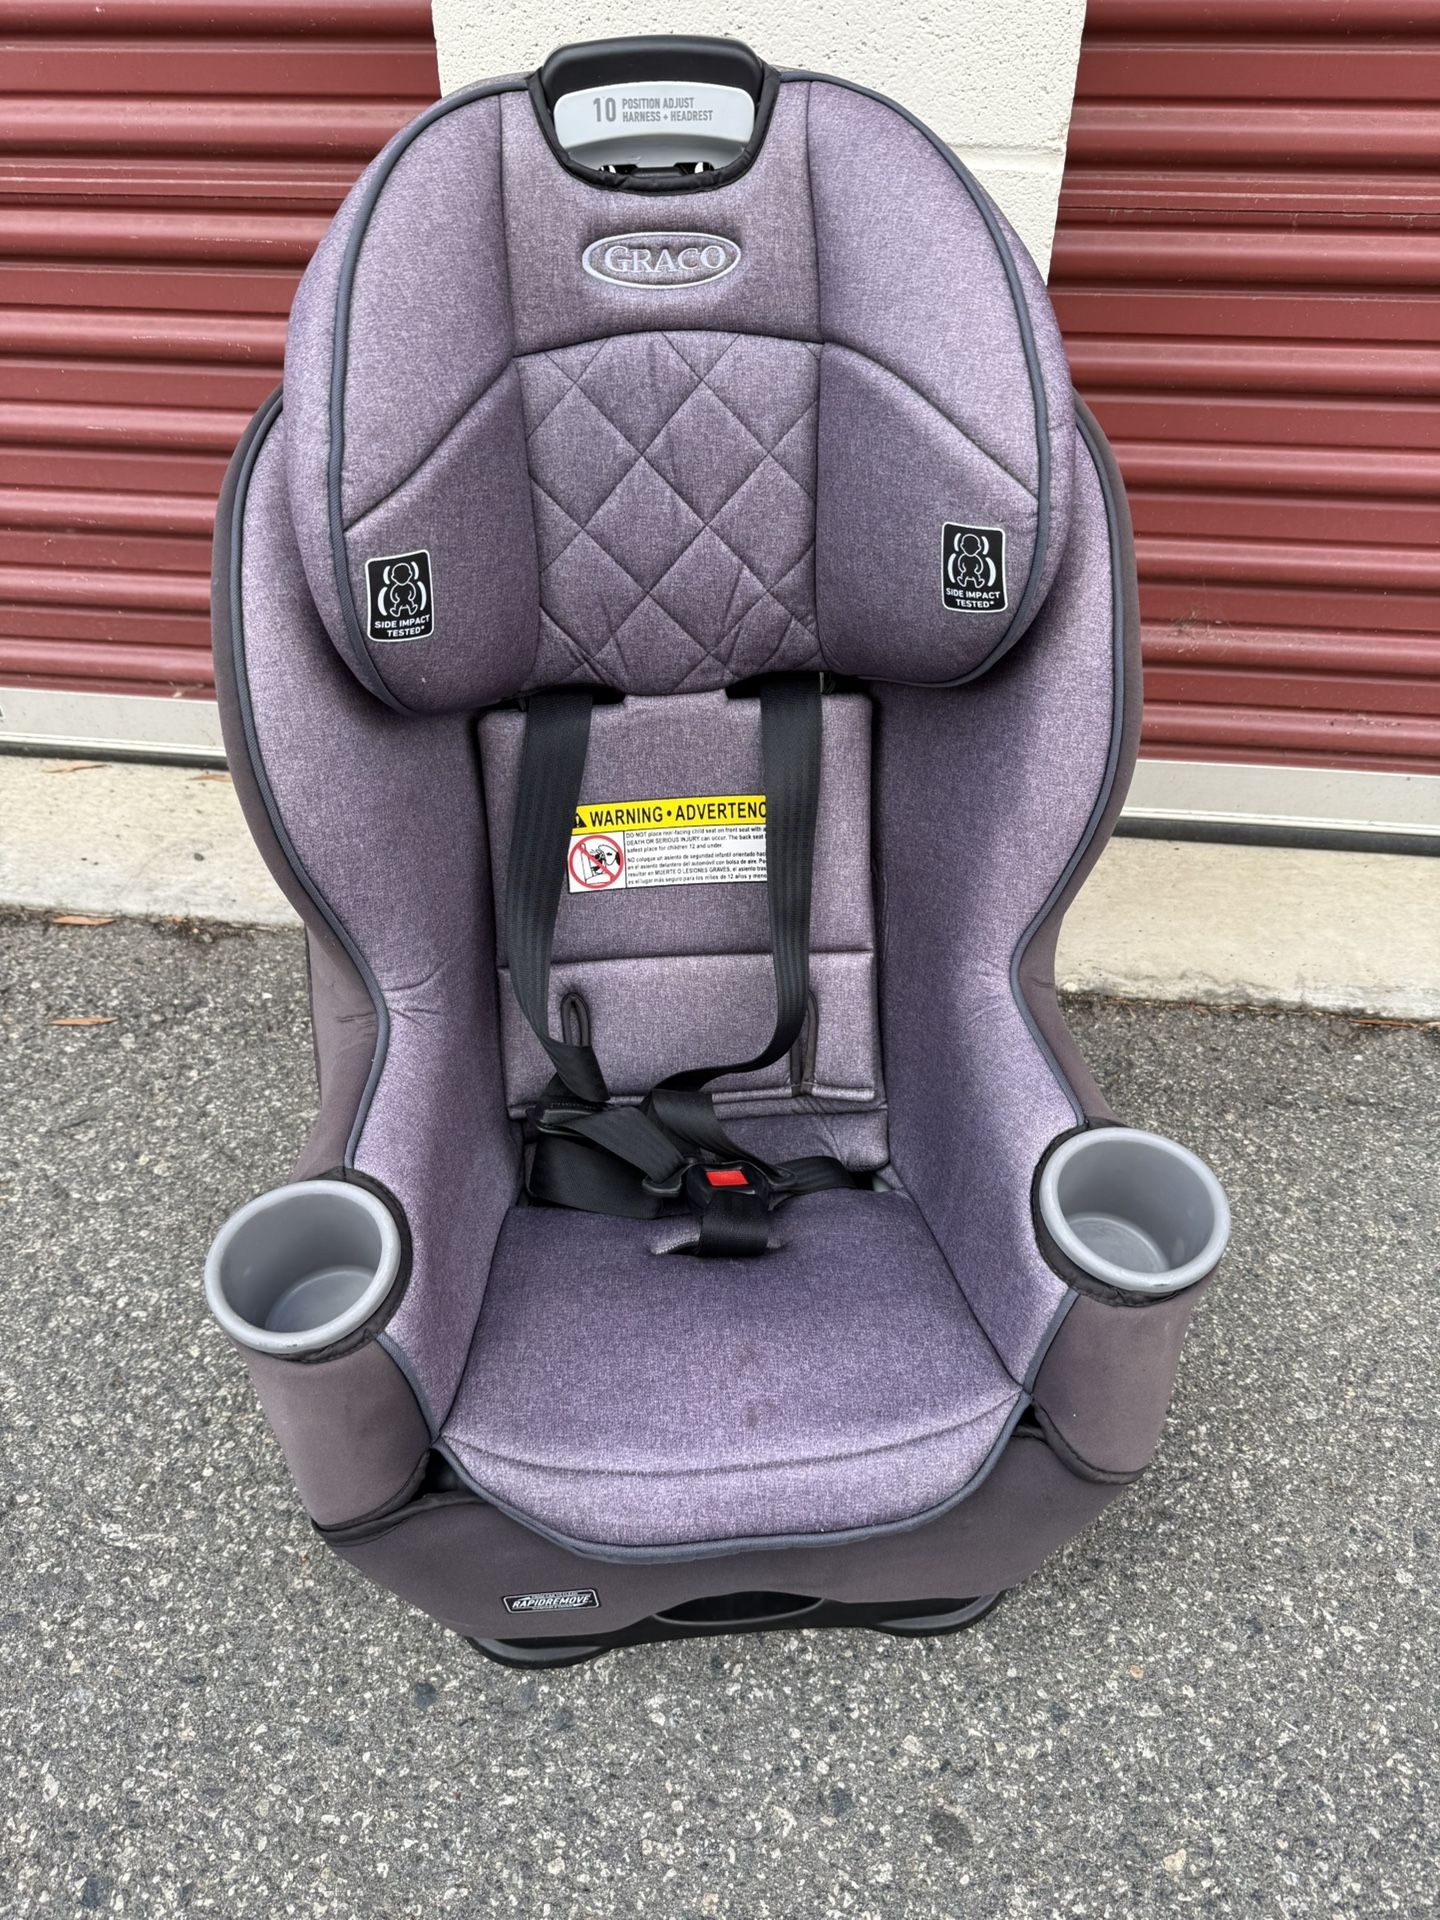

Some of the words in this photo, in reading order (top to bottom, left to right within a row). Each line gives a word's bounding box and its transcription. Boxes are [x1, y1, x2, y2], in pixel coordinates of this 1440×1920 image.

[593, 97, 616, 122] 10
[622, 98, 661, 110] POSITION
[663, 97, 694, 109] ADJUST
[622, 111, 661, 122] HARNESS
[671, 110, 713, 121] HEADREST
[604, 245, 726, 273] GRACO
[946, 588, 964, 598] SIDE
[965, 591, 1000, 599] IMPACT
[374, 620, 397, 628] SIDE
[400, 614, 430, 626] IMPACT
[589, 806, 663, 827] WARNING
